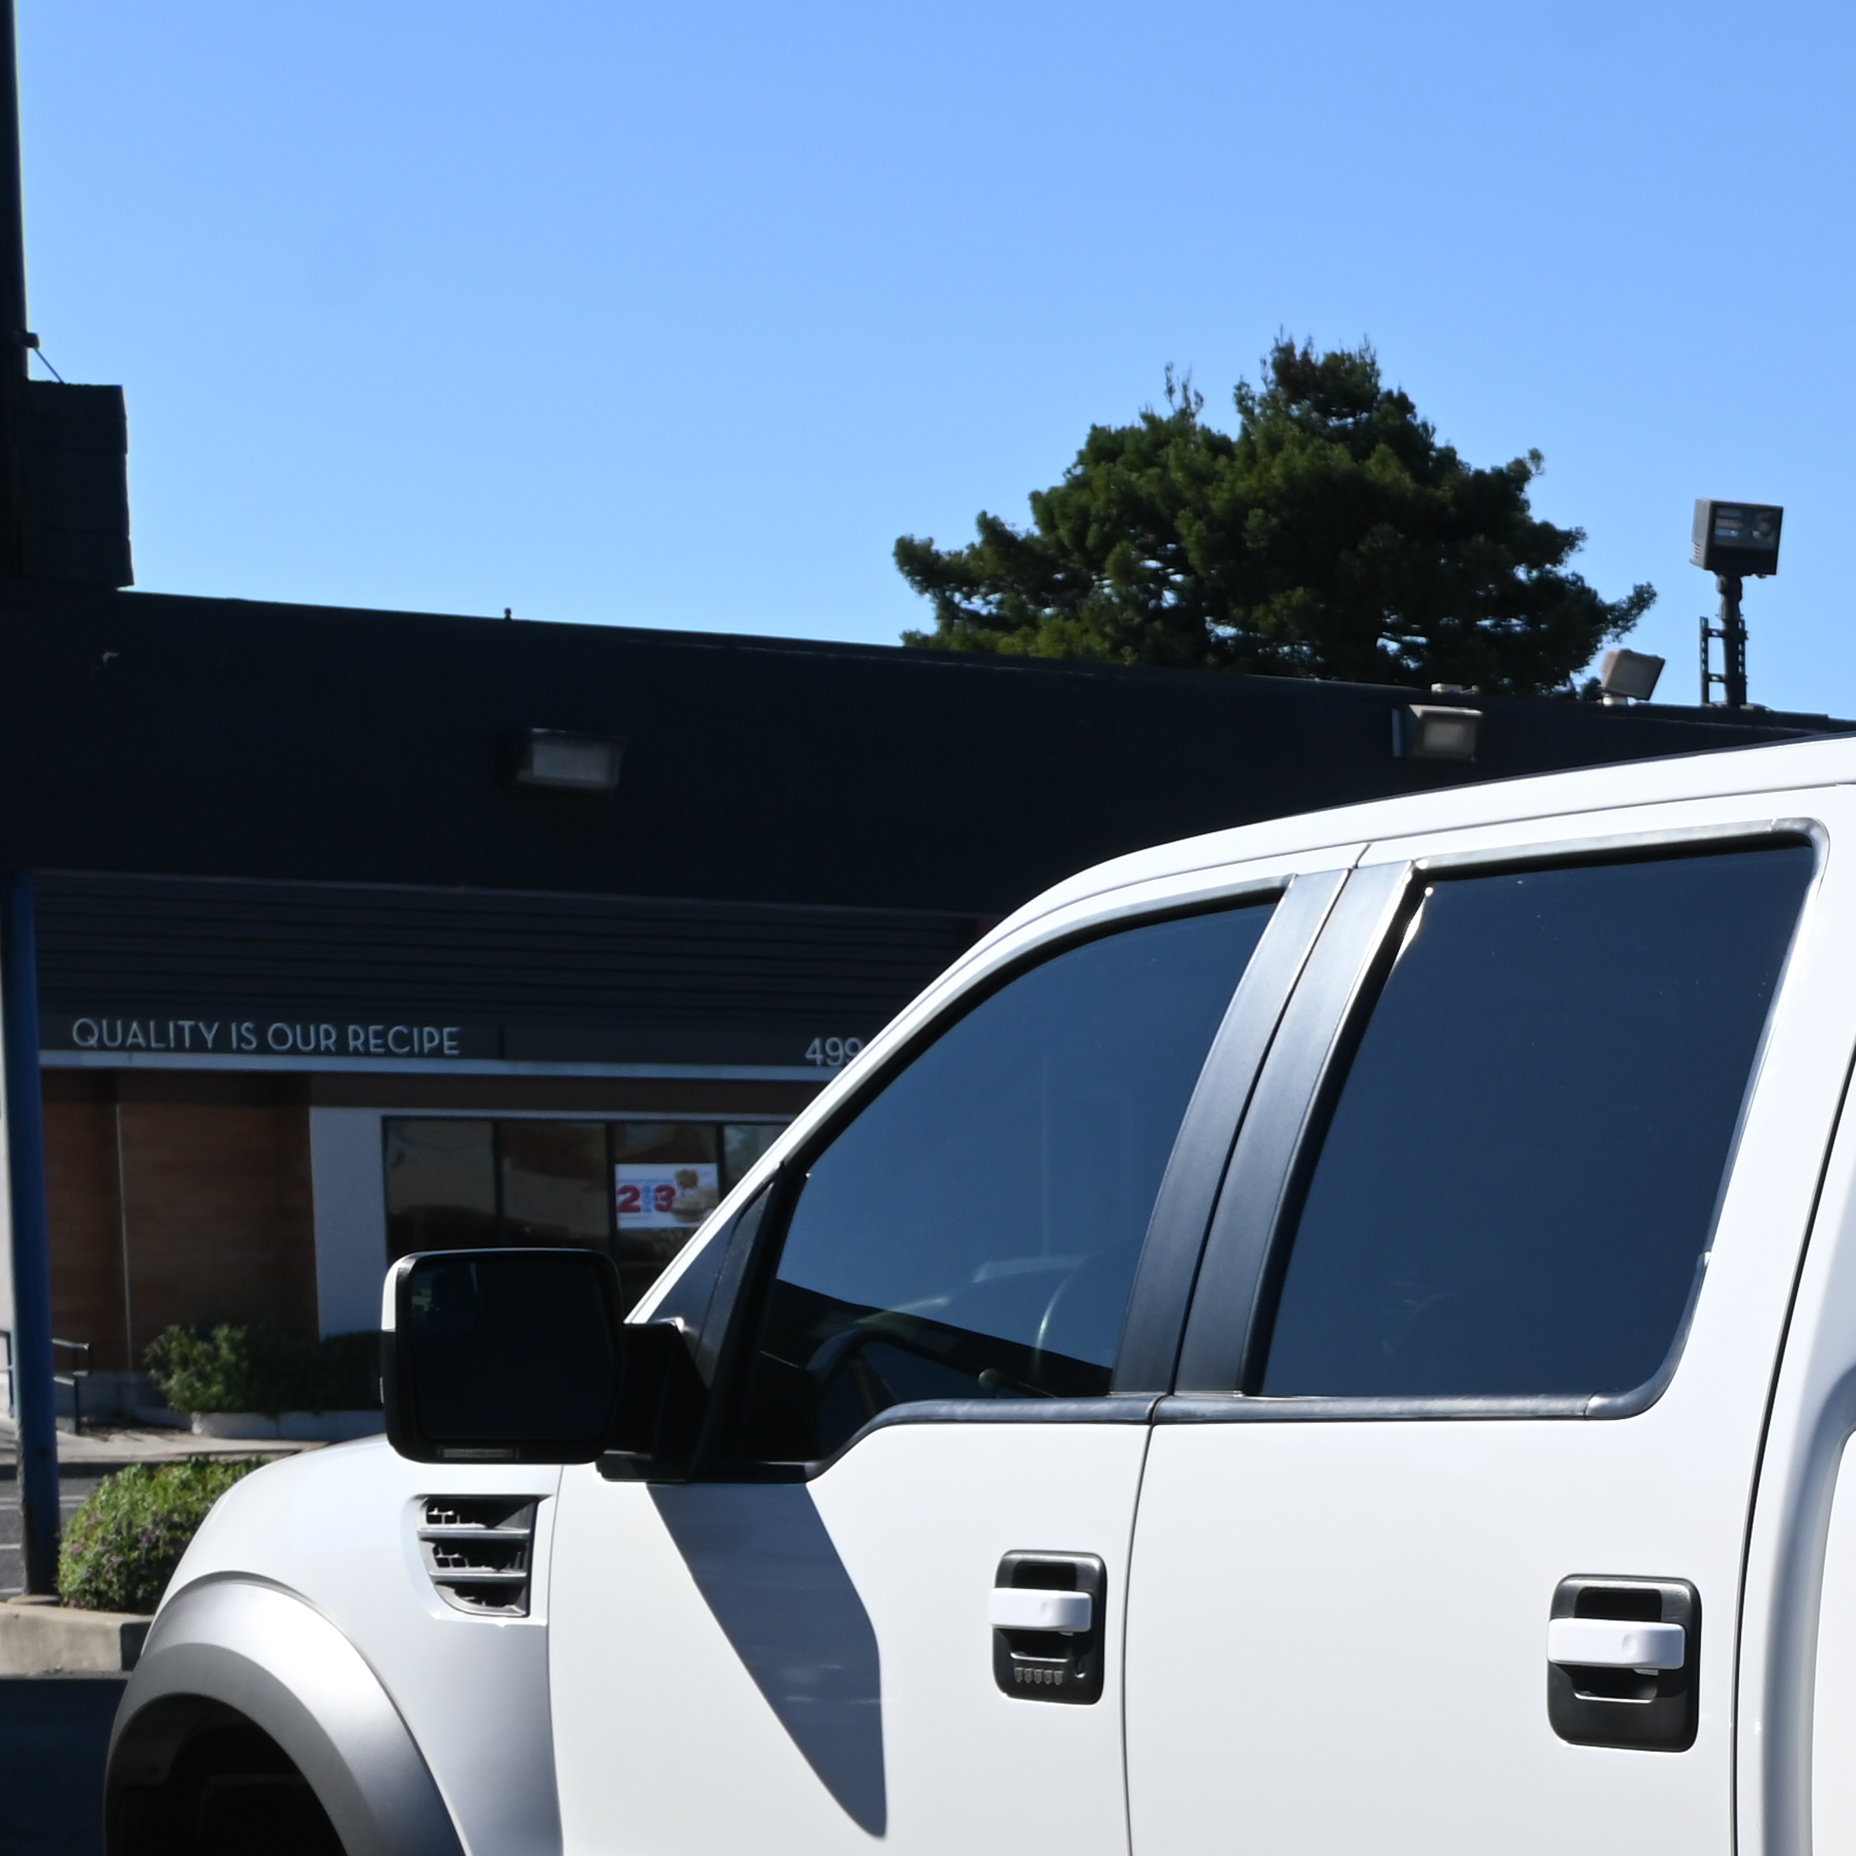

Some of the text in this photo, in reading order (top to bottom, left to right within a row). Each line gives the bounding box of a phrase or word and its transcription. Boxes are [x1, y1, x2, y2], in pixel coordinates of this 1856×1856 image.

[72, 1017, 461, 1056] QUALITY IS OUR RECIPE
